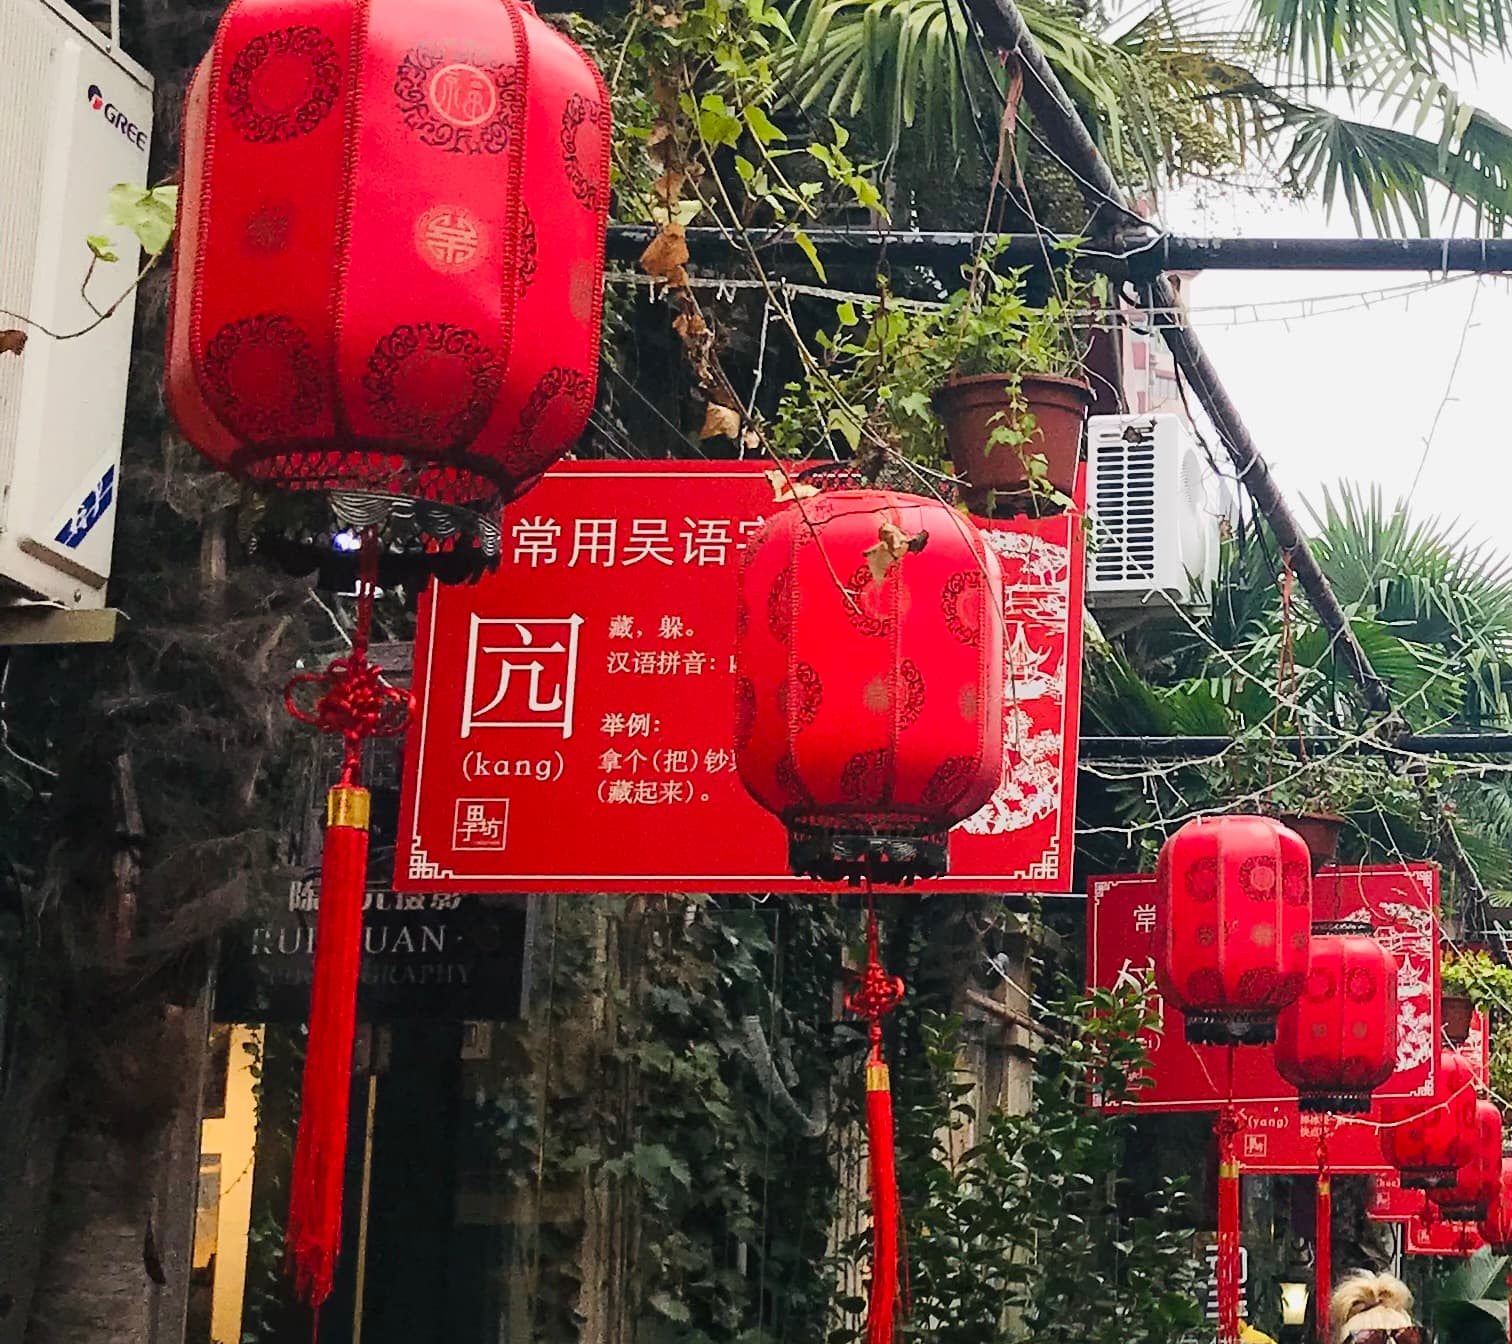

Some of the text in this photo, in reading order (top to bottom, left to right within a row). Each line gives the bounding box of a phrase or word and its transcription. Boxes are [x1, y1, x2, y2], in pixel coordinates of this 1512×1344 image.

[104, 103, 148, 152] GREE
[461, 612, 585, 740] 囥
[462, 751, 564, 782] (kang)
[1247, 1115, 1289, 1129] (yang)
